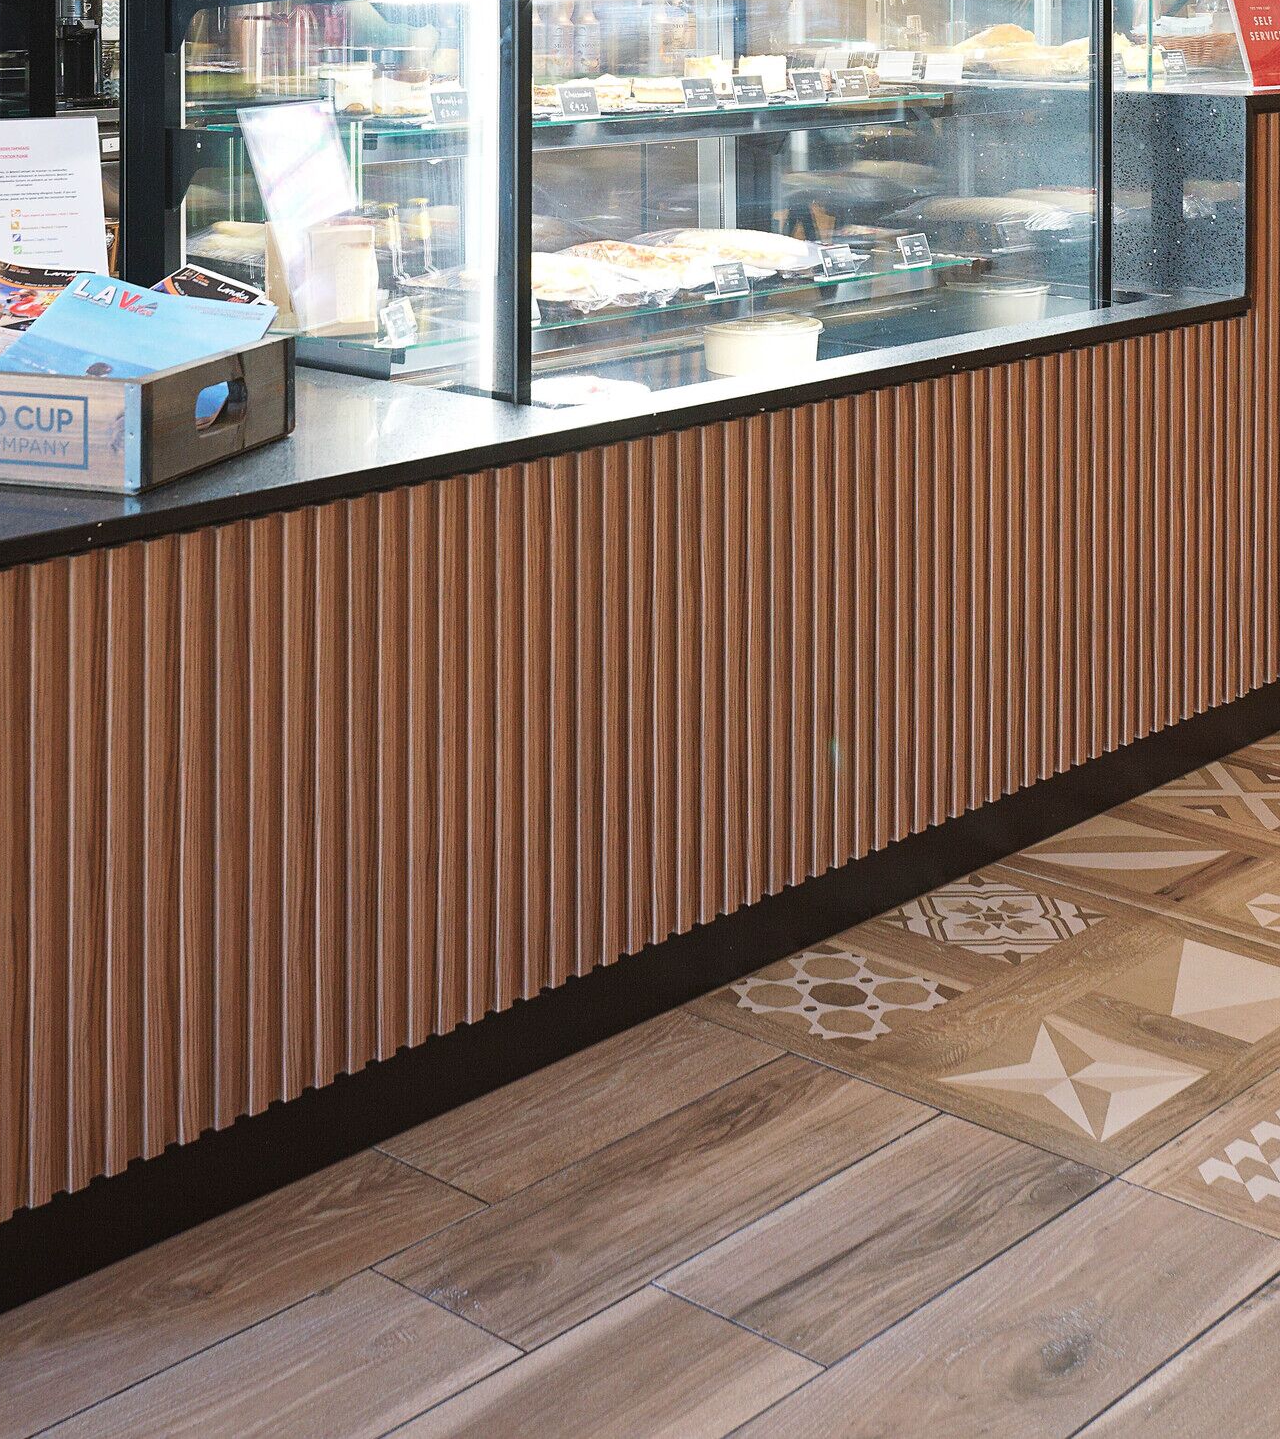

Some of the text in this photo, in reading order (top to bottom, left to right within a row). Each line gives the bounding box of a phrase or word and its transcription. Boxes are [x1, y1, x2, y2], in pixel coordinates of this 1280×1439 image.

[1253, 16, 1273, 26] SELF
[73, 279, 117, 306] L.A
[14, 405, 74, 433] CUP
